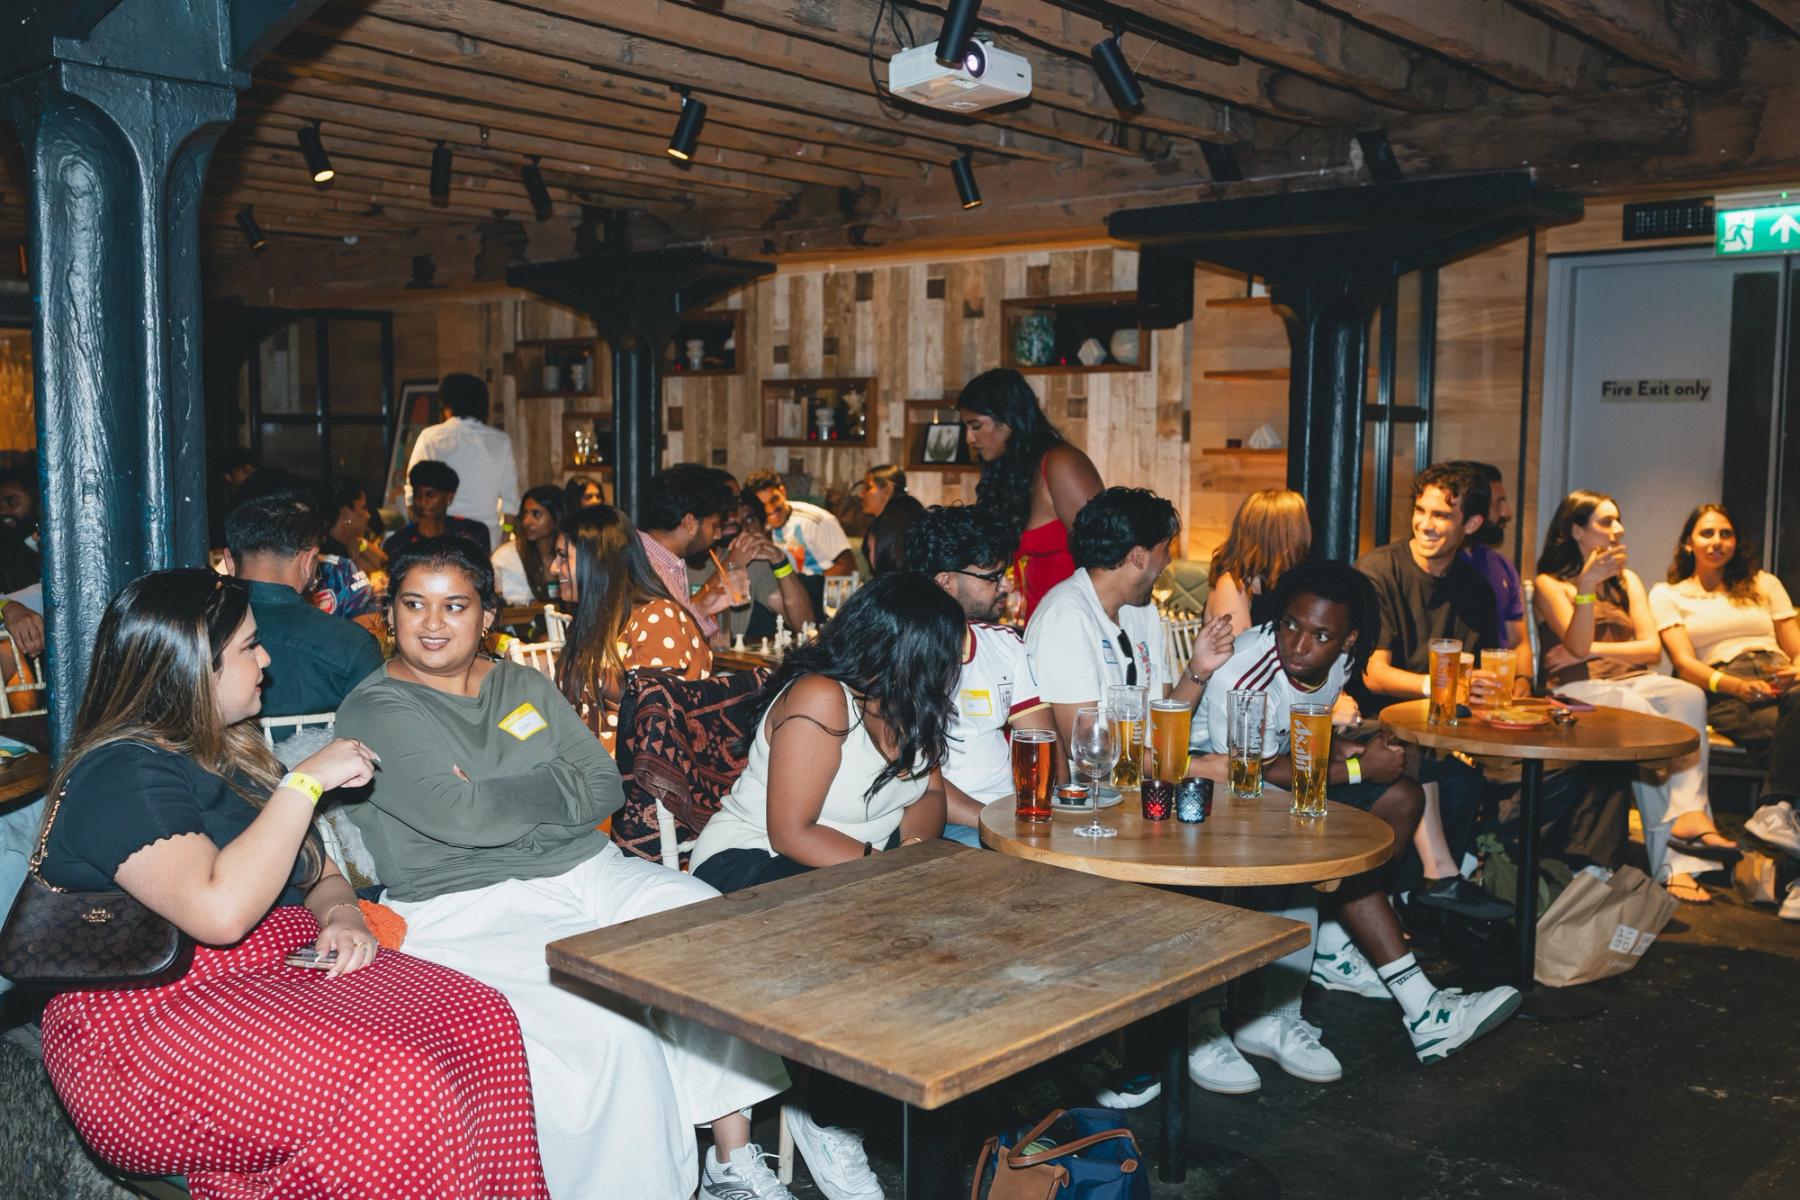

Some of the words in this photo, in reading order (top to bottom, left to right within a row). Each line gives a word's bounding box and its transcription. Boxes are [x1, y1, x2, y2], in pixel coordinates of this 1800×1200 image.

[1602, 380, 1632, 397] Fire
[1638, 379, 1670, 396] Exit
[1674, 379, 1710, 401] only
